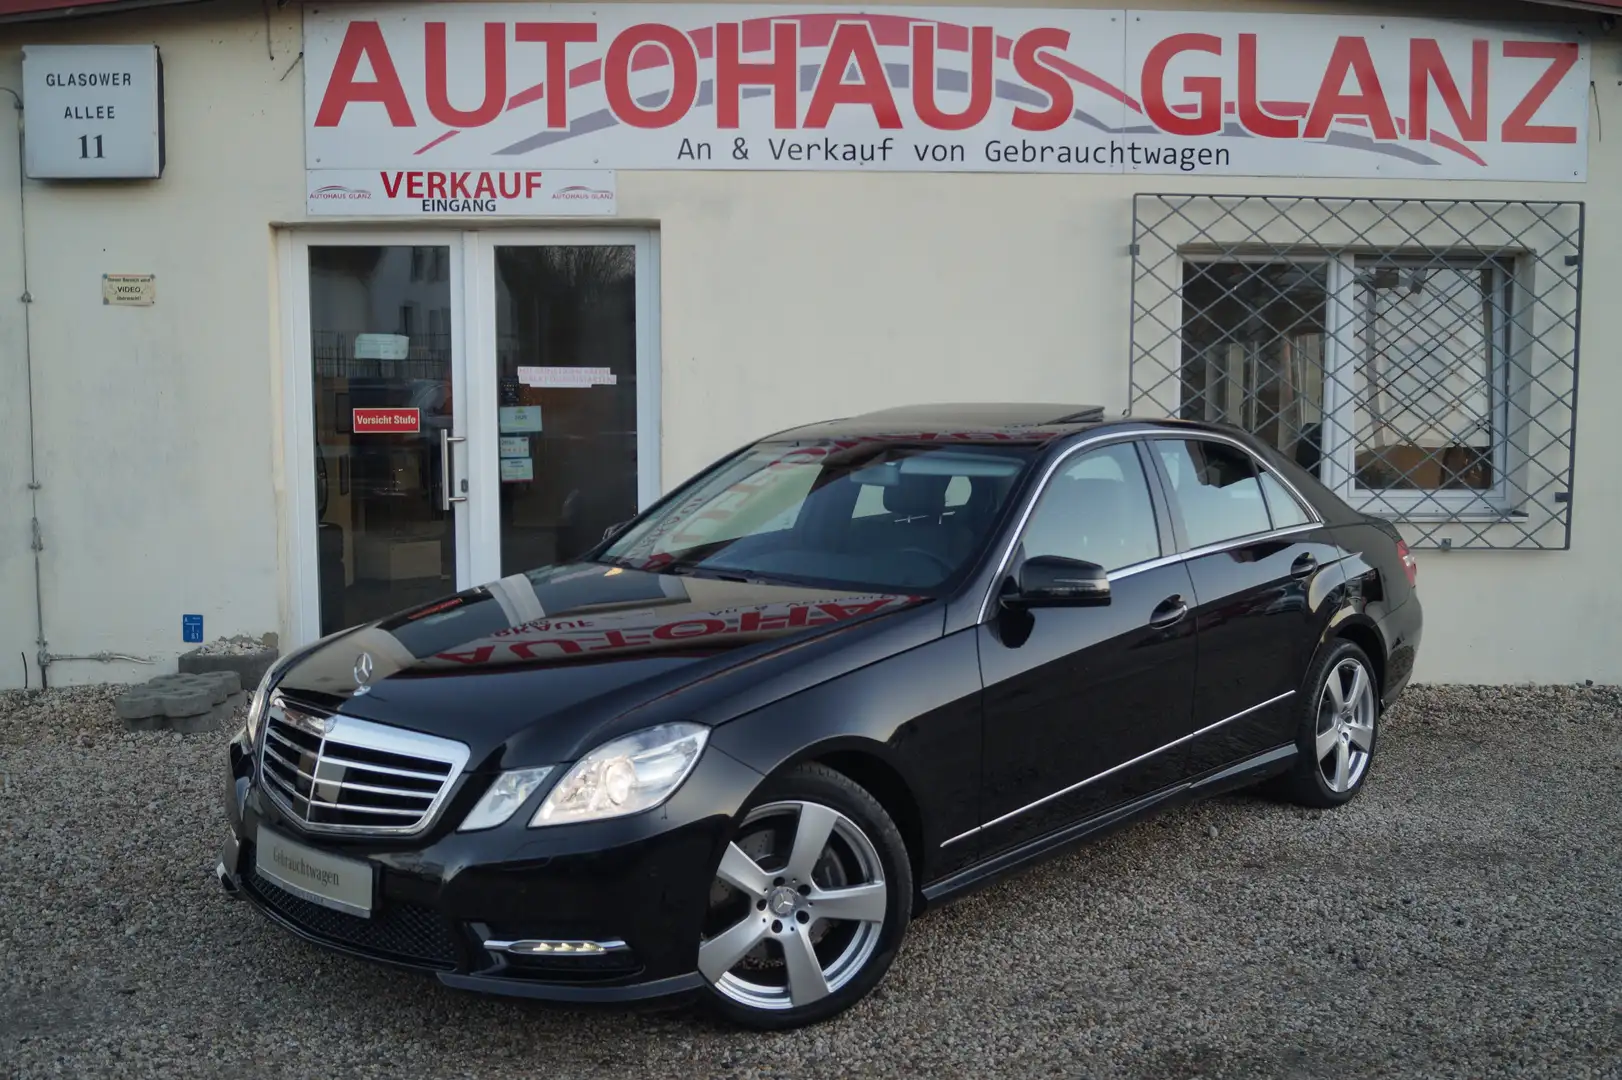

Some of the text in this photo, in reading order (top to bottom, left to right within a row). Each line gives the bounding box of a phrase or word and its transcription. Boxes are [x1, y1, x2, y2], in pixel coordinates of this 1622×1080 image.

[46, 73, 131, 87] GLASOWER
[314, 20, 1580, 144] AUTOHAUS GLANZ
[64, 105, 115, 120] ALLEE
[77, 134, 106, 160] 11
[677, 138, 1229, 172] An & Verkauf von Gebrauchtwagen
[380, 171, 542, 199] VERKAUF
[422, 198, 497, 212] EINGANG
[357, 415, 416, 425] Vorsicht Stufe
[272, 845, 340, 887] Gebrauchtwagen
